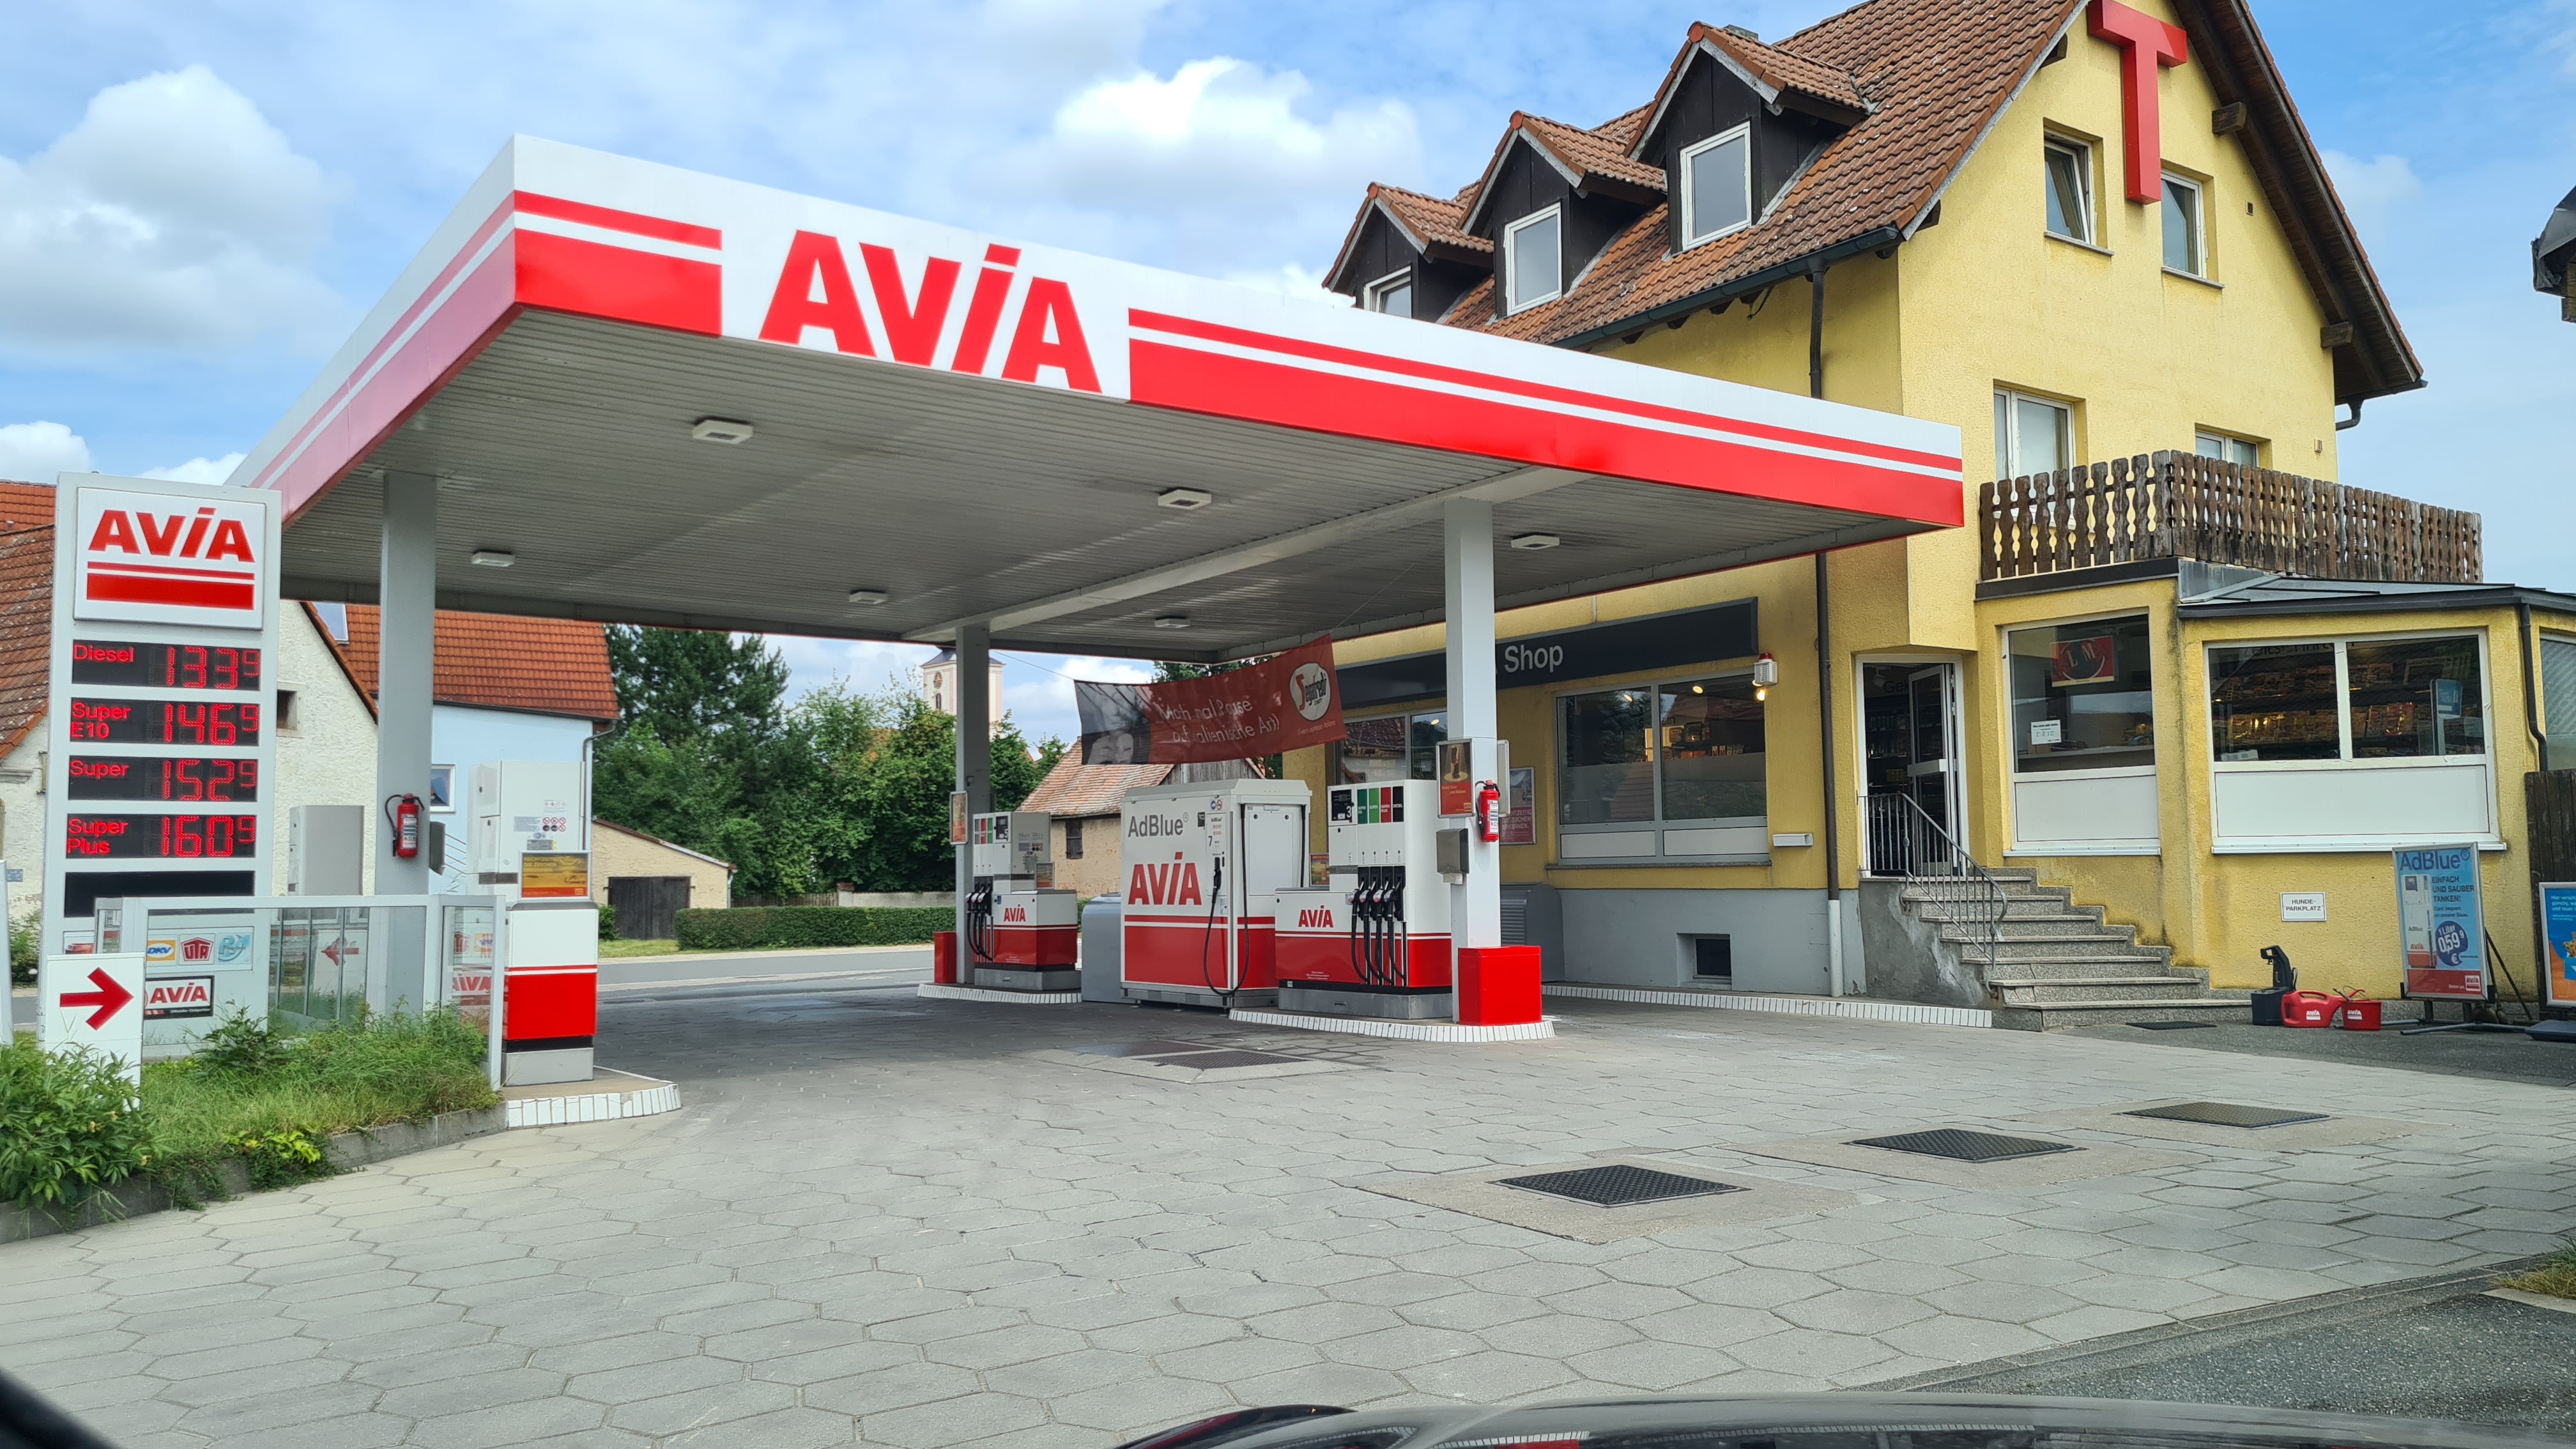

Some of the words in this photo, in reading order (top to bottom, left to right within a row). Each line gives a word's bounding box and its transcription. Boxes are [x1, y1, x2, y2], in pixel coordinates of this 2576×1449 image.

[2087, 0, 2187, 205] T
[73, 643, 135, 663] Diesel
[1504, 643, 1563, 673] Shop
[72, 702, 132, 721] Super
[1159, 702, 1192, 721] Mach
[1216, 699, 1253, 717] Pause
[70, 722, 110, 739] E10
[1258, 712, 1280, 734] Art!
[69, 760, 130, 779] Super
[1346, 805, 1352, 818] 3
[68, 818, 129, 838] Super
[66, 838, 111, 855] Plus
[1208, 835, 1213, 847] 7
[2432, 875, 2460, 884] EINFACH
[2441, 925, 2456, 935] Liter
[183, 938, 211, 959] UTA
